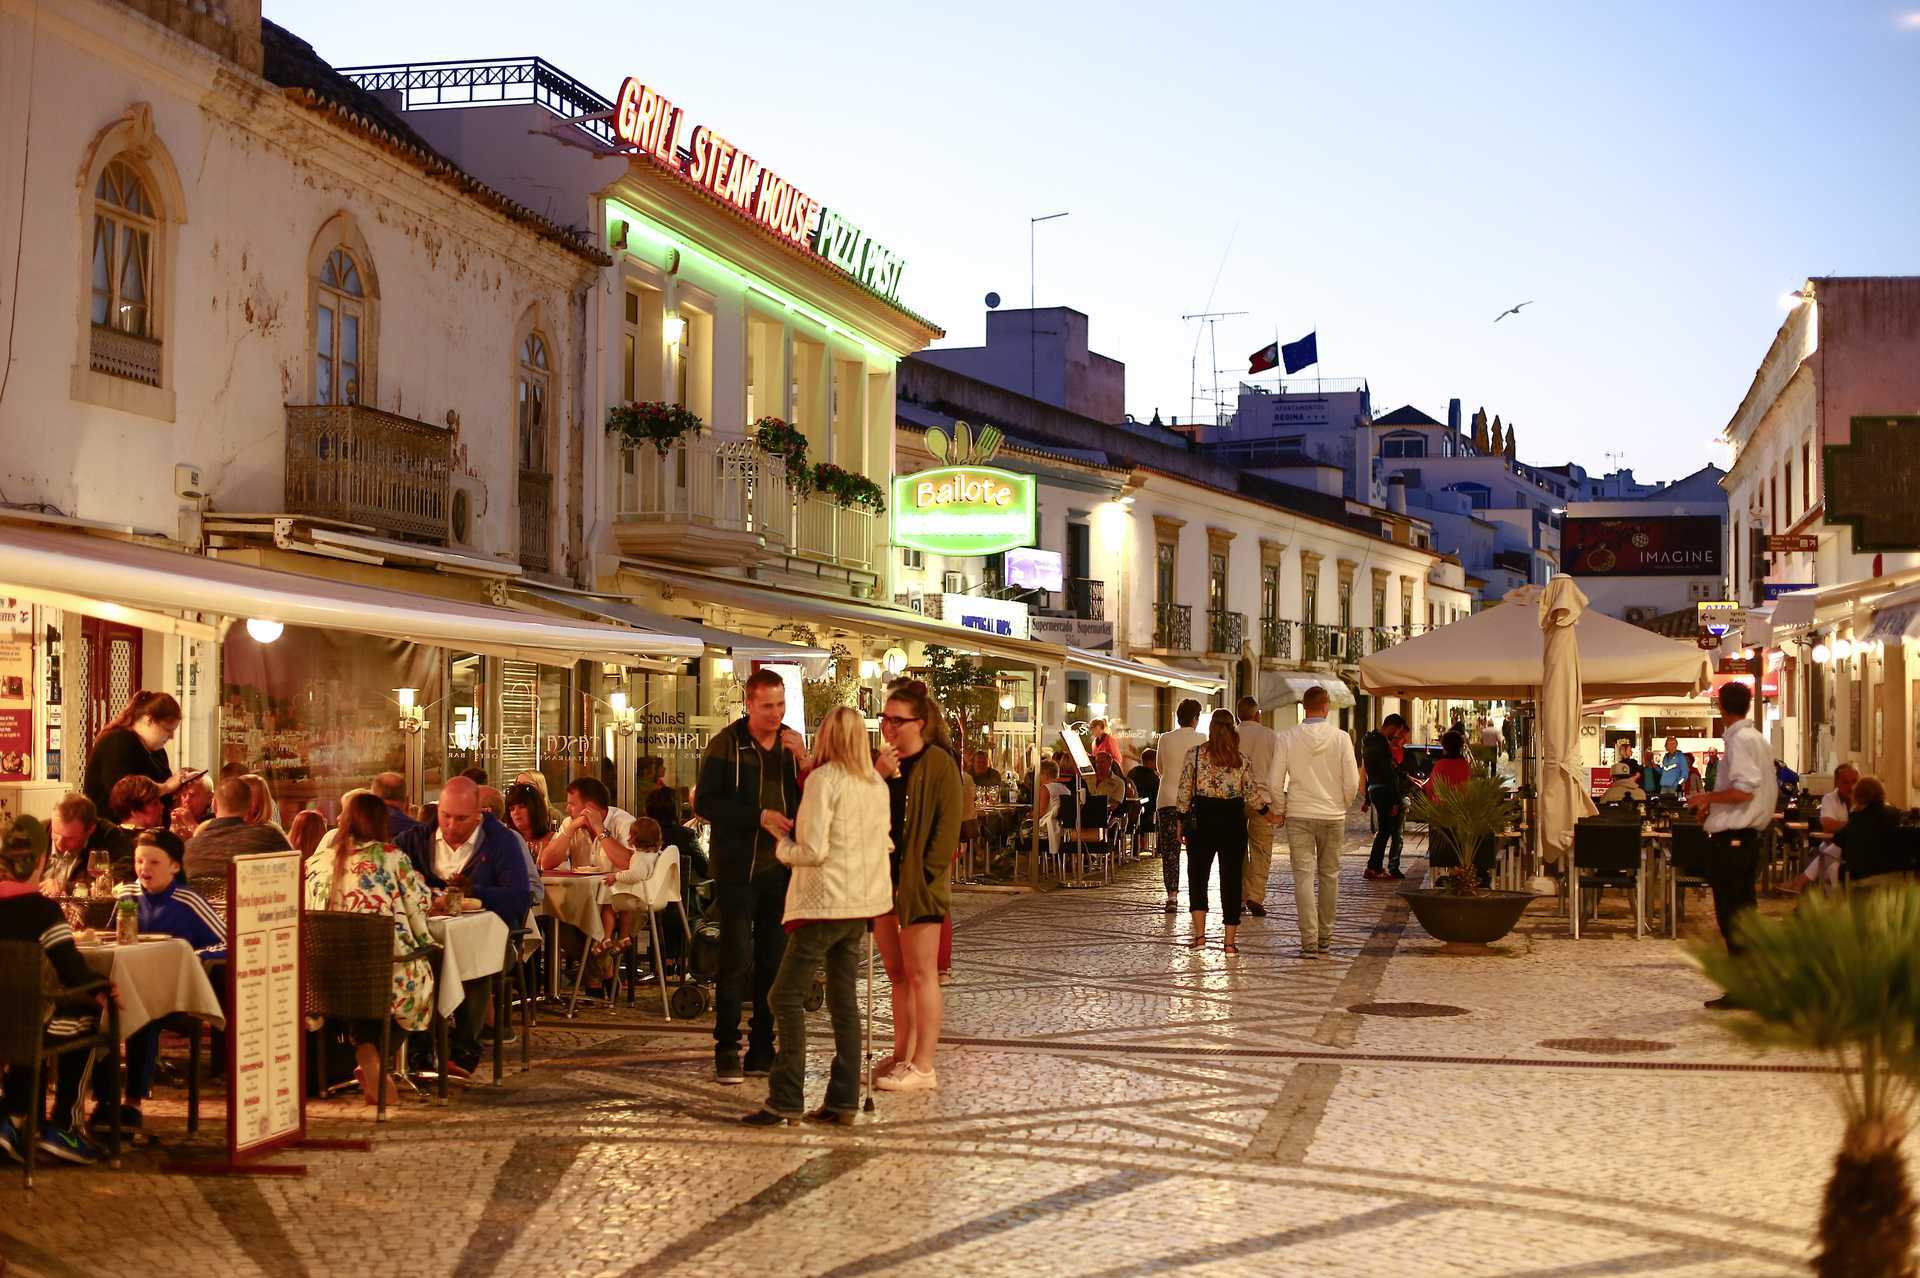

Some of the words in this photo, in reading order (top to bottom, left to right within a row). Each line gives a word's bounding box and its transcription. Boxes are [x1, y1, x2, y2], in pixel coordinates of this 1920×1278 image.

[615, 77, 685, 169] GRILL
[689, 125, 759, 209] STEAK
[756, 168, 819, 249] HOUSE
[1274, 413, 1305, 421] REGINA
[1640, 551, 1713, 563] IMAGINE
